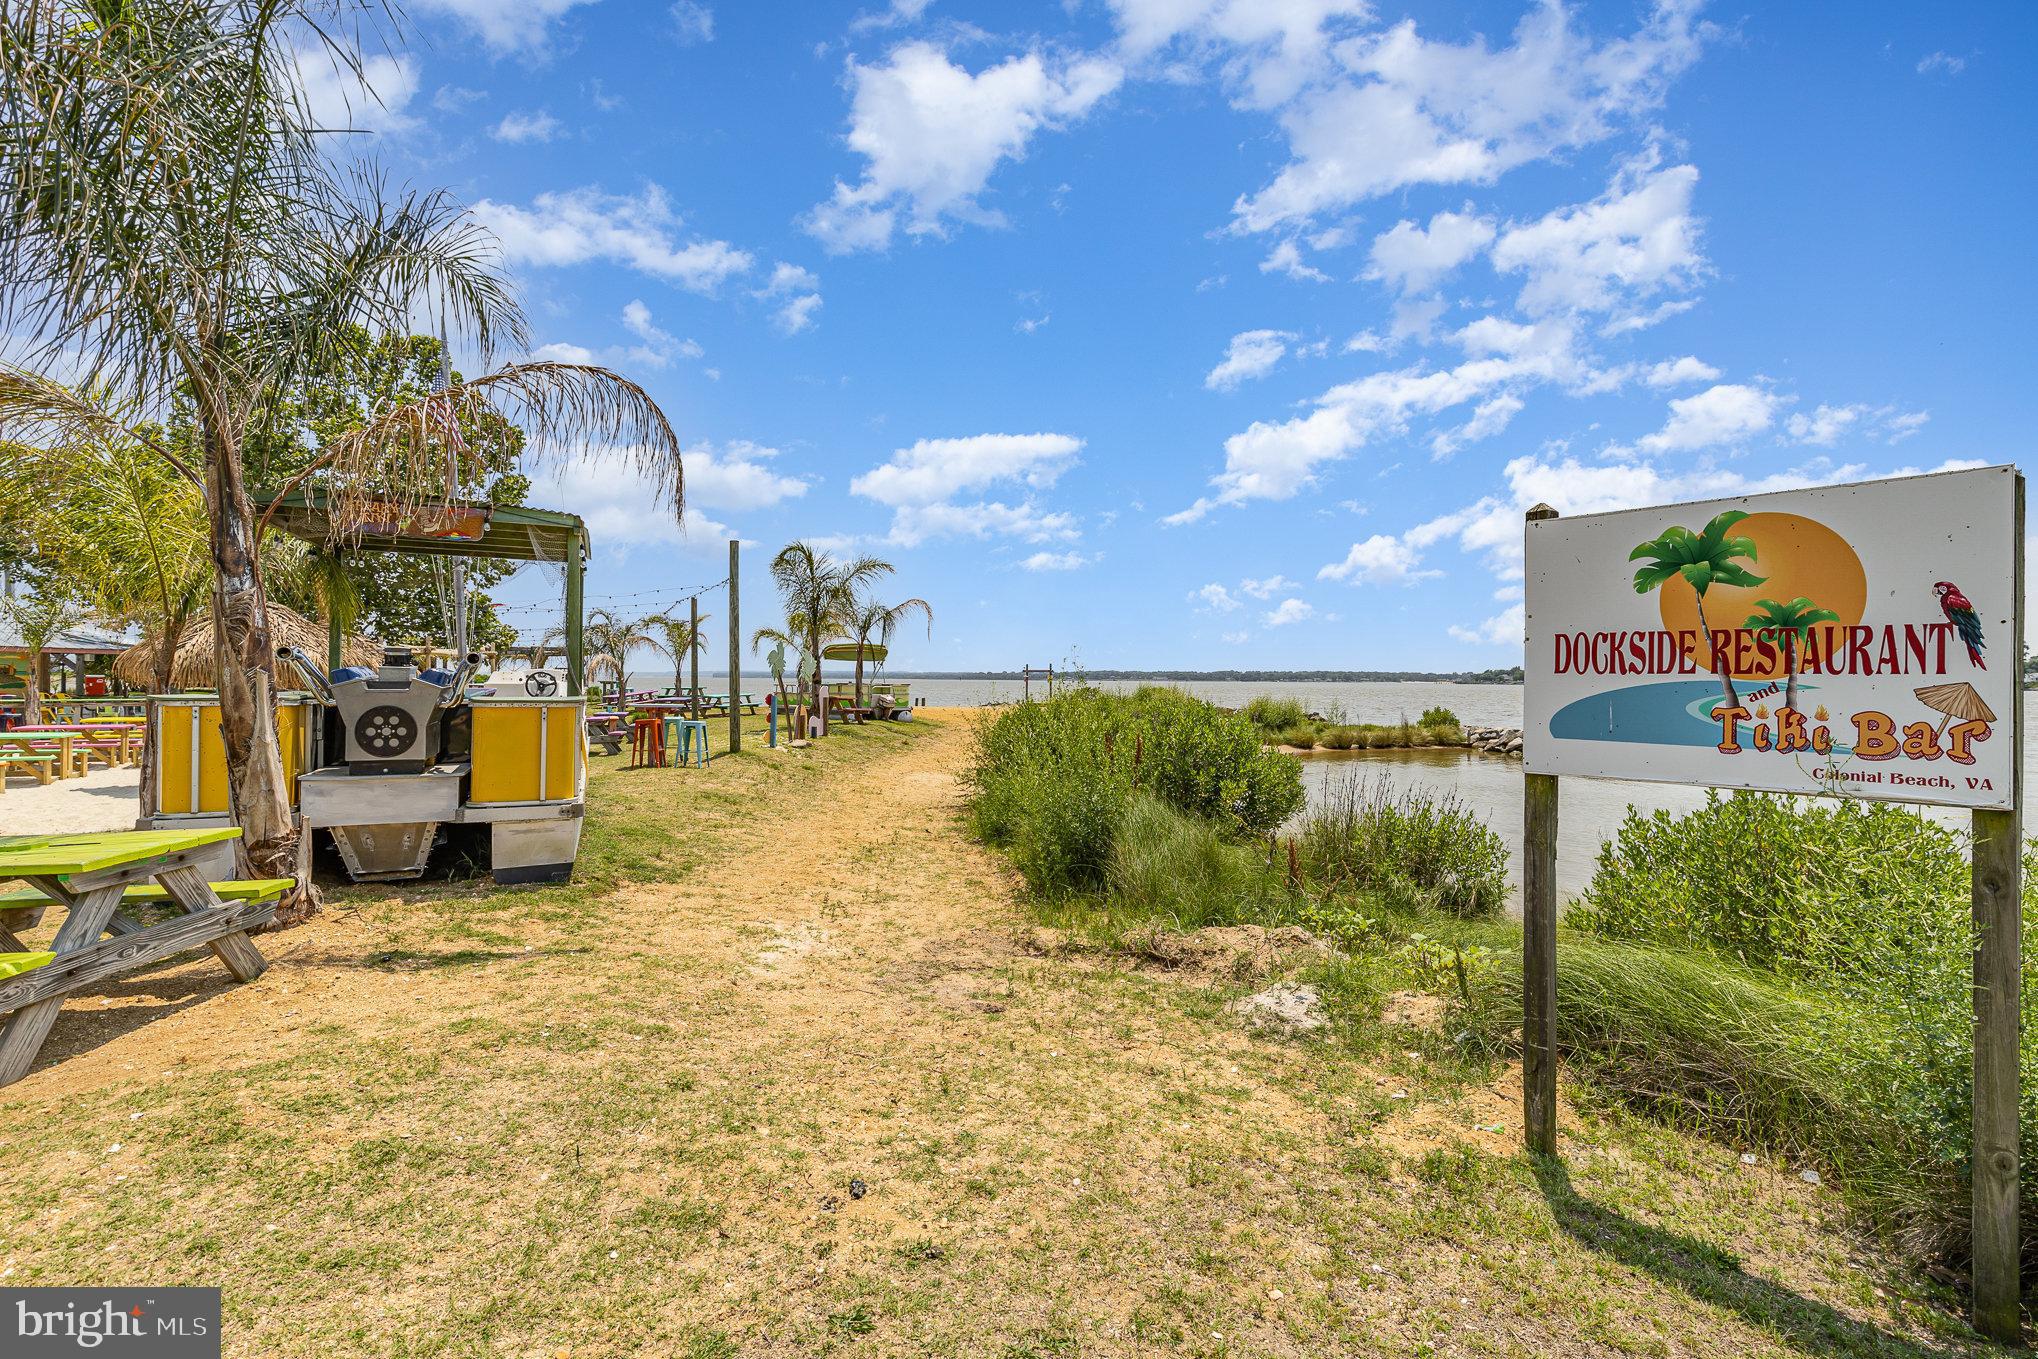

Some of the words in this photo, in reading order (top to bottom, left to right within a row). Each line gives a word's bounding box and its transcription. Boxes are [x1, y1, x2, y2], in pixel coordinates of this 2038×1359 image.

[1553, 628, 1697, 676] DOCKSIDE
[1710, 623, 1956, 676] RESTAURANT
[1748, 681, 1781, 703] and
[1710, 704, 1833, 755] Tiki
[1850, 710, 1993, 765] Bar
[1812, 767, 1883, 784] Colonial
[1889, 772, 1956, 790] Beach,
[1965, 777, 1994, 791] VA
